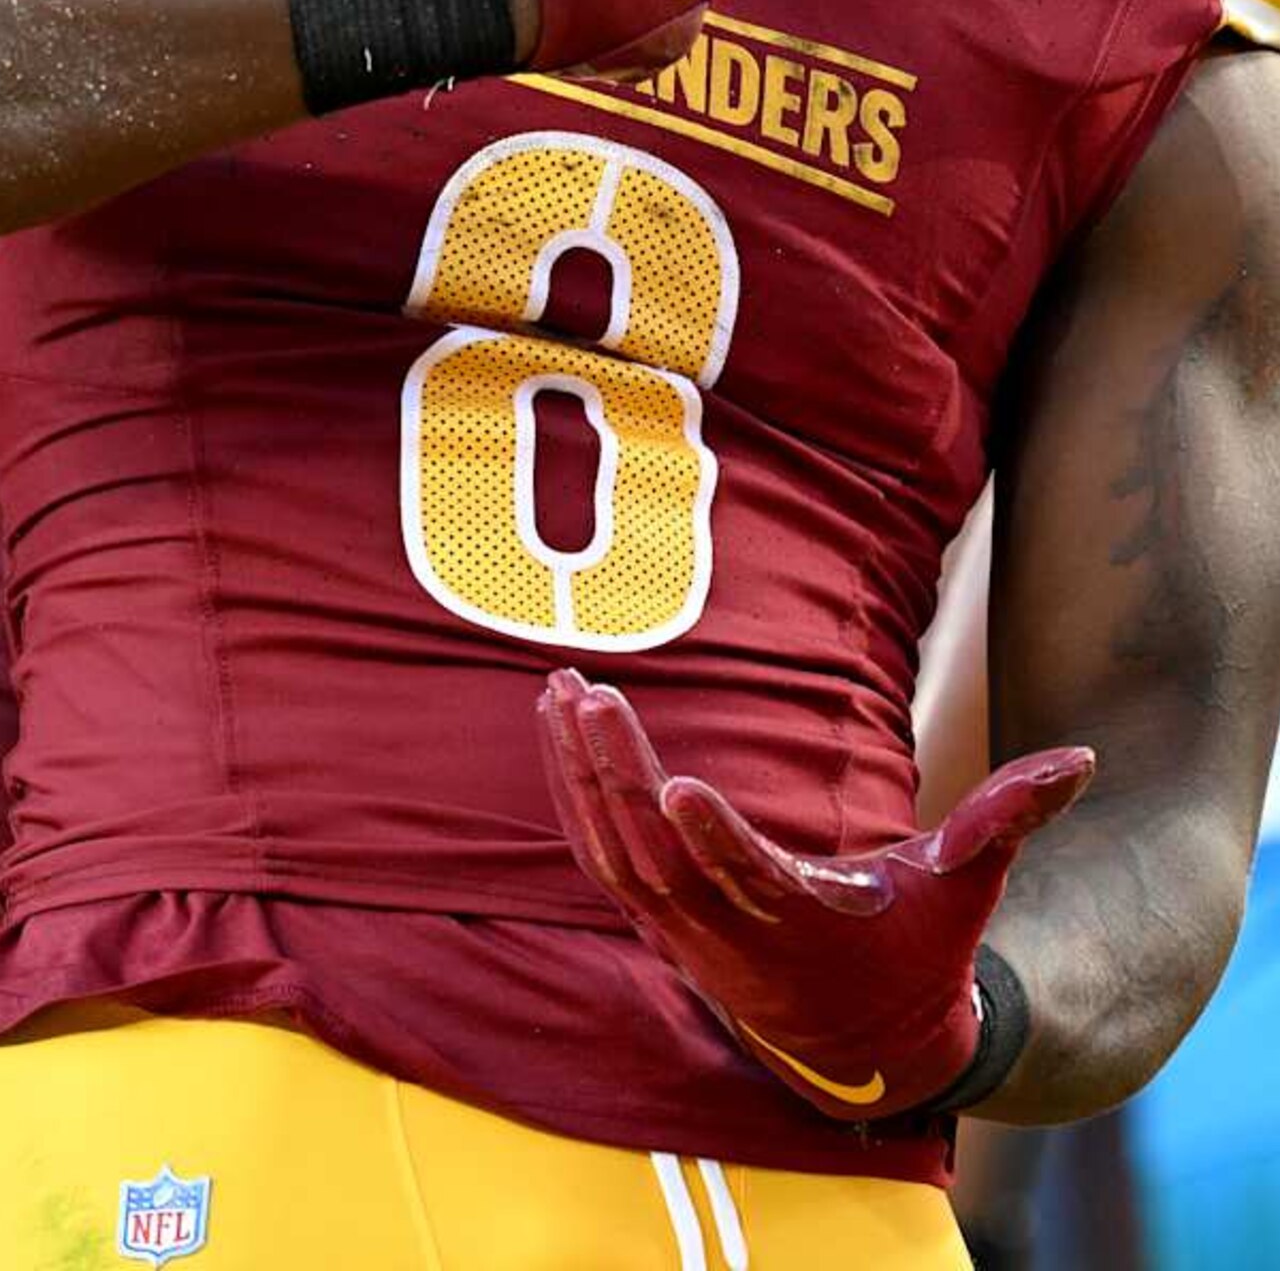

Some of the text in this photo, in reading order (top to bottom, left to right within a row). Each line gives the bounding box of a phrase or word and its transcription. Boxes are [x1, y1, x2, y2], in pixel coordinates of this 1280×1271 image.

[635, 33, 907, 183] NDERS
[400, 130, 740, 653] 8
[131, 1211, 191, 1246] NFL
